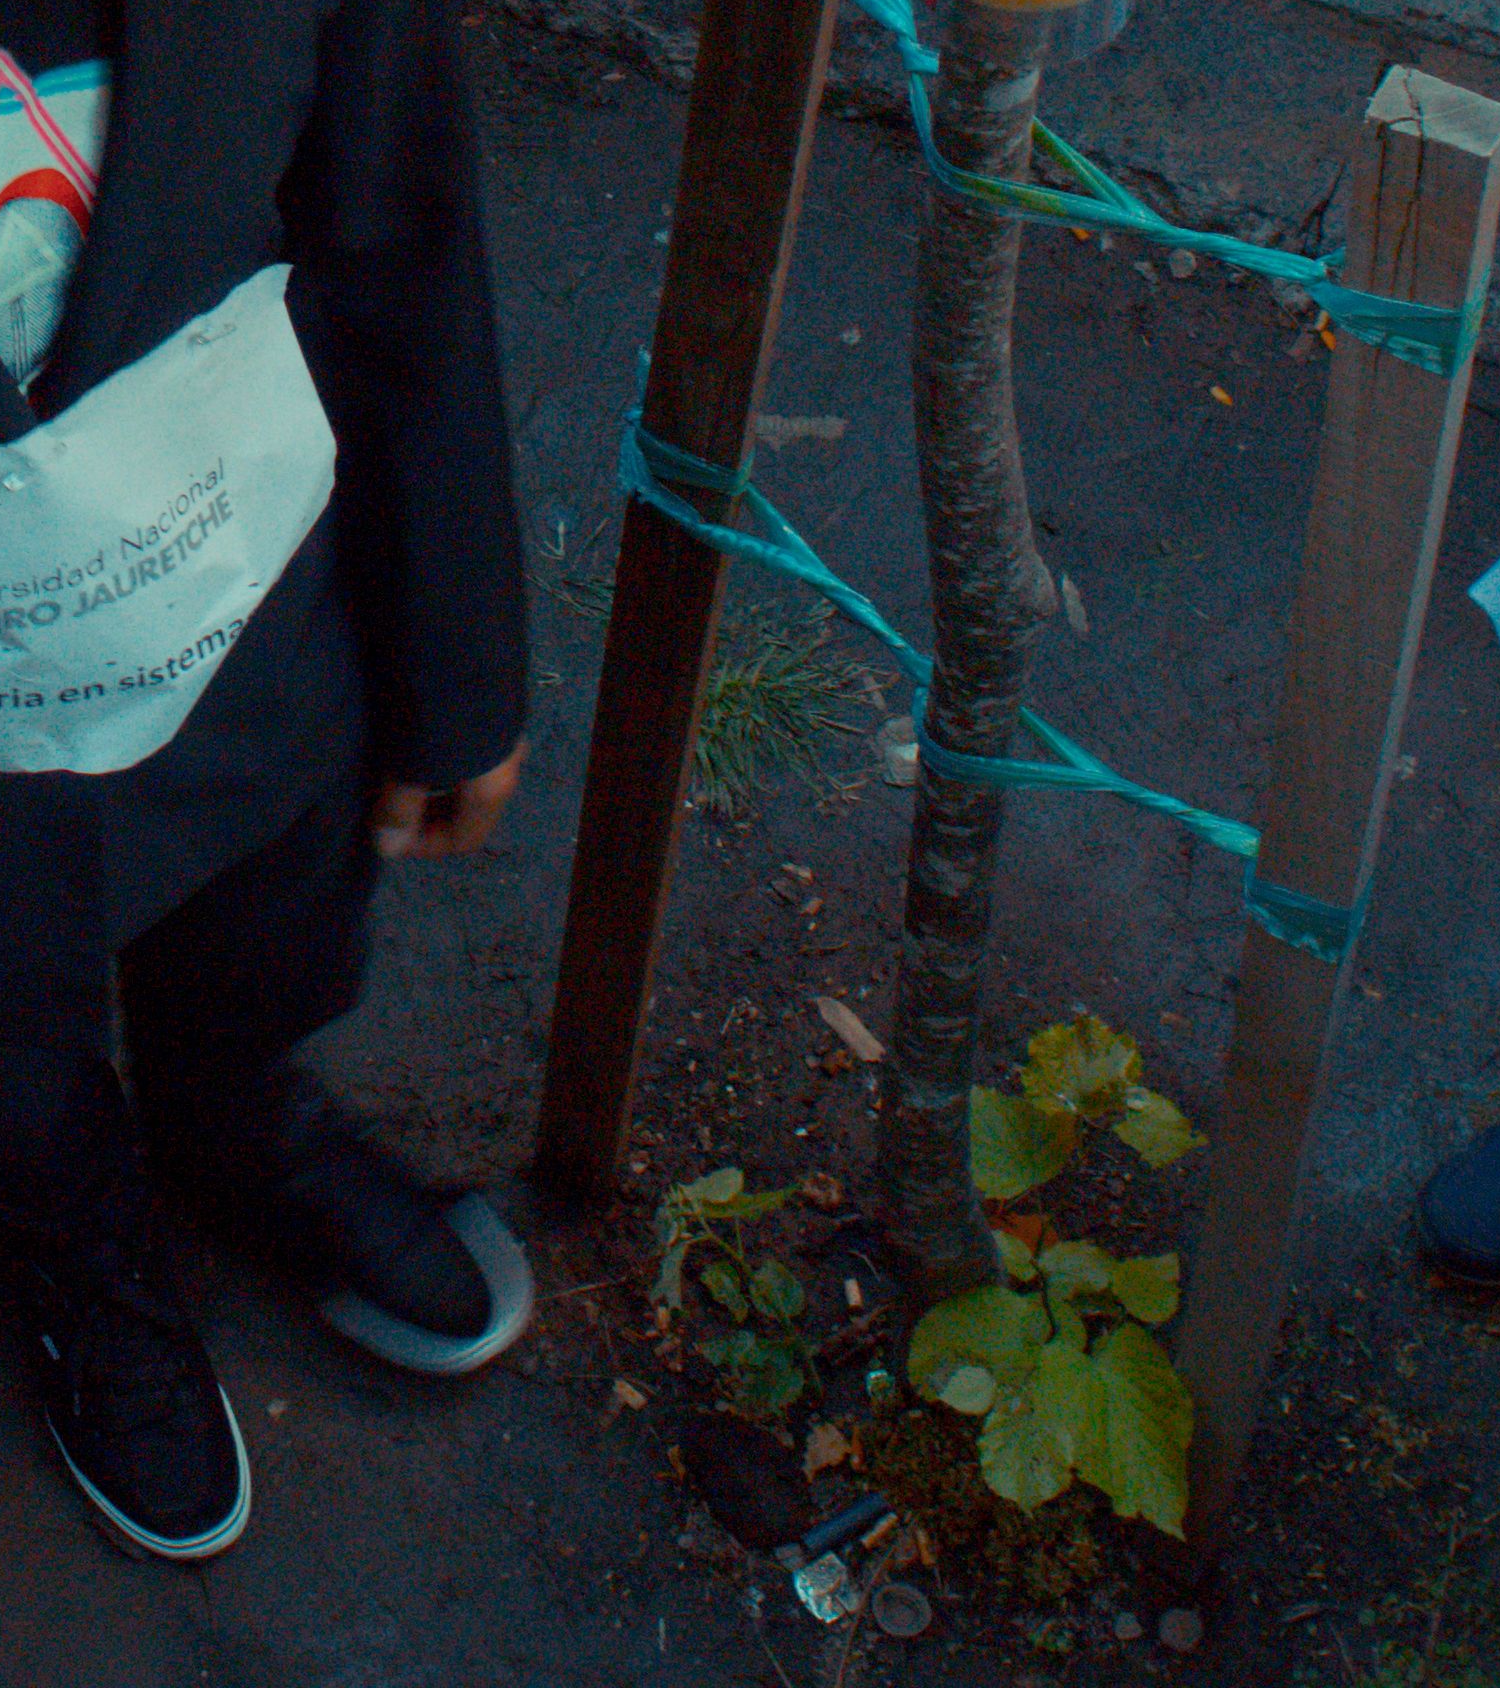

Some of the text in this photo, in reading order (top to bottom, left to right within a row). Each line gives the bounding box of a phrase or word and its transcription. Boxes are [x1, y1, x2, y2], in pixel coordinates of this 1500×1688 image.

[72, 489, 235, 619] JAURETCHE
[120, 456, 226, 560] Nacional
[58, 681, 105, 705] en
